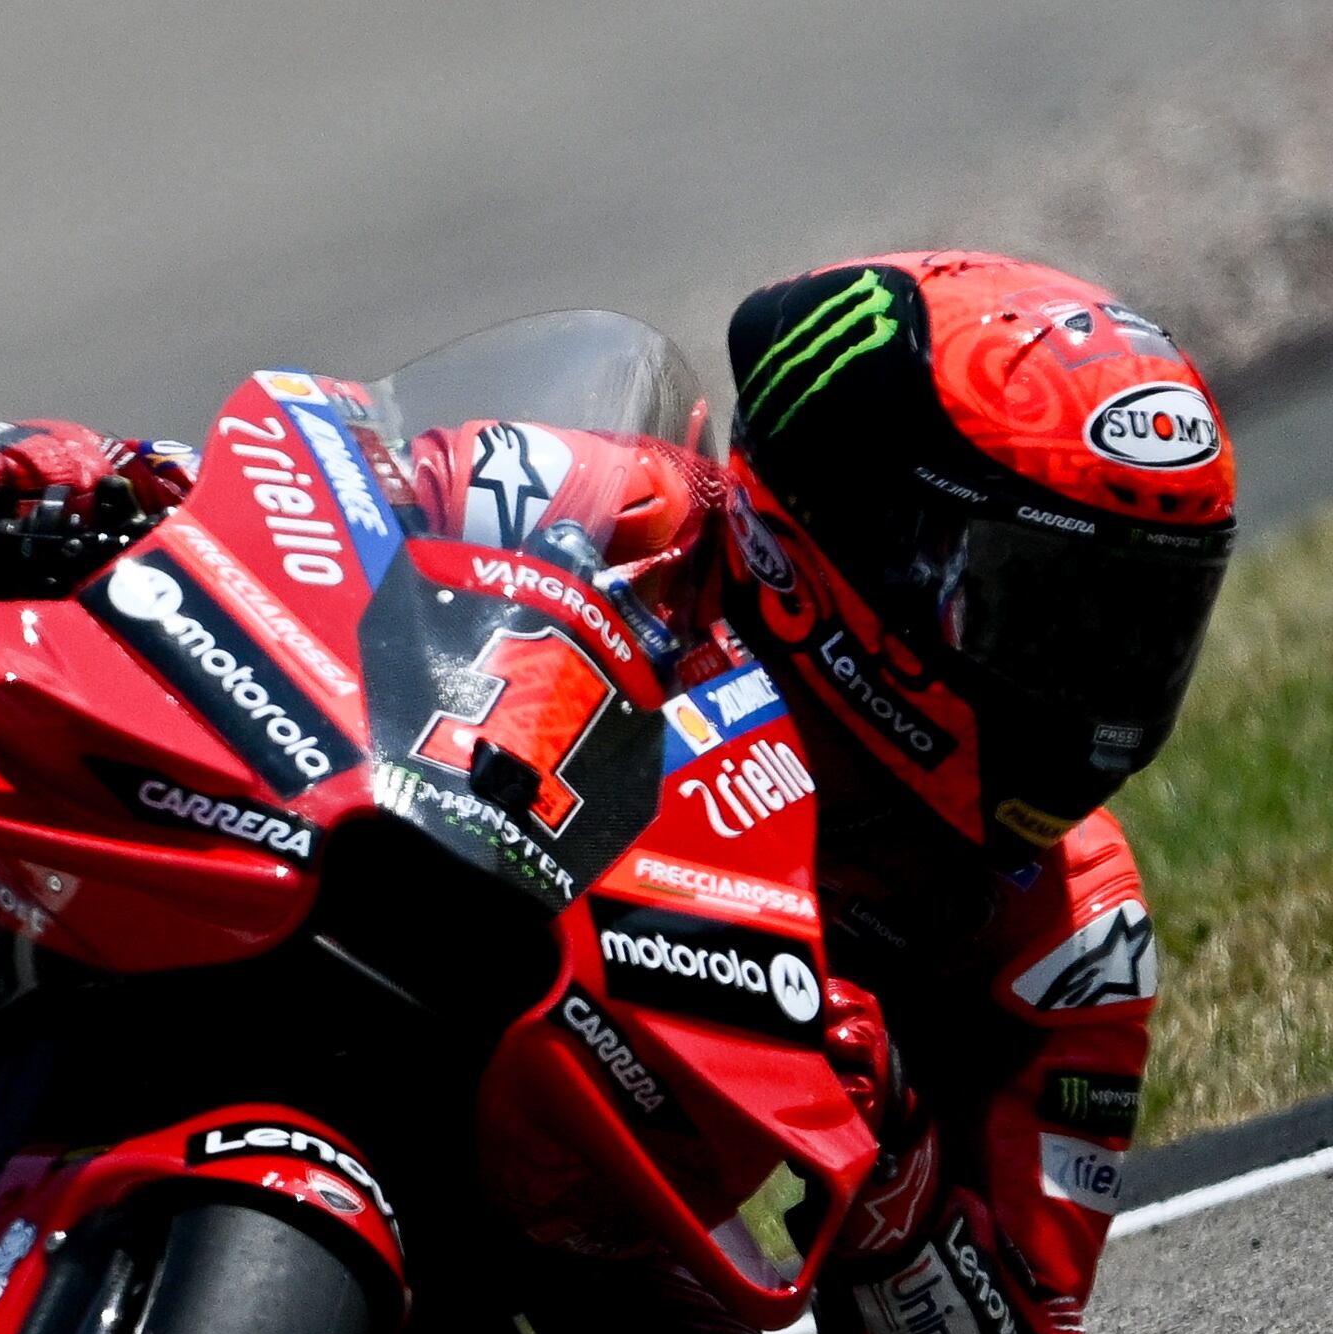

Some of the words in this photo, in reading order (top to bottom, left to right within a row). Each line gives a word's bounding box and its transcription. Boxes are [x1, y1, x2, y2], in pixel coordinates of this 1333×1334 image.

[1104, 408, 1219, 448] SUOMY
[1016, 504, 1097, 537] CARRERA
[171, 522, 361, 697] FRECCIAROSSA
[162, 613, 332, 779] motorola
[409, 627, 618, 839] 1
[819, 630, 934, 753] Lenovo
[139, 779, 312, 858] CARRERA
[635, 857, 817, 919] FRECCIAROSSA
[600, 928, 768, 993] motorola
[562, 994, 667, 1115] CARRERA
[204, 1126, 406, 1258] Lenov
